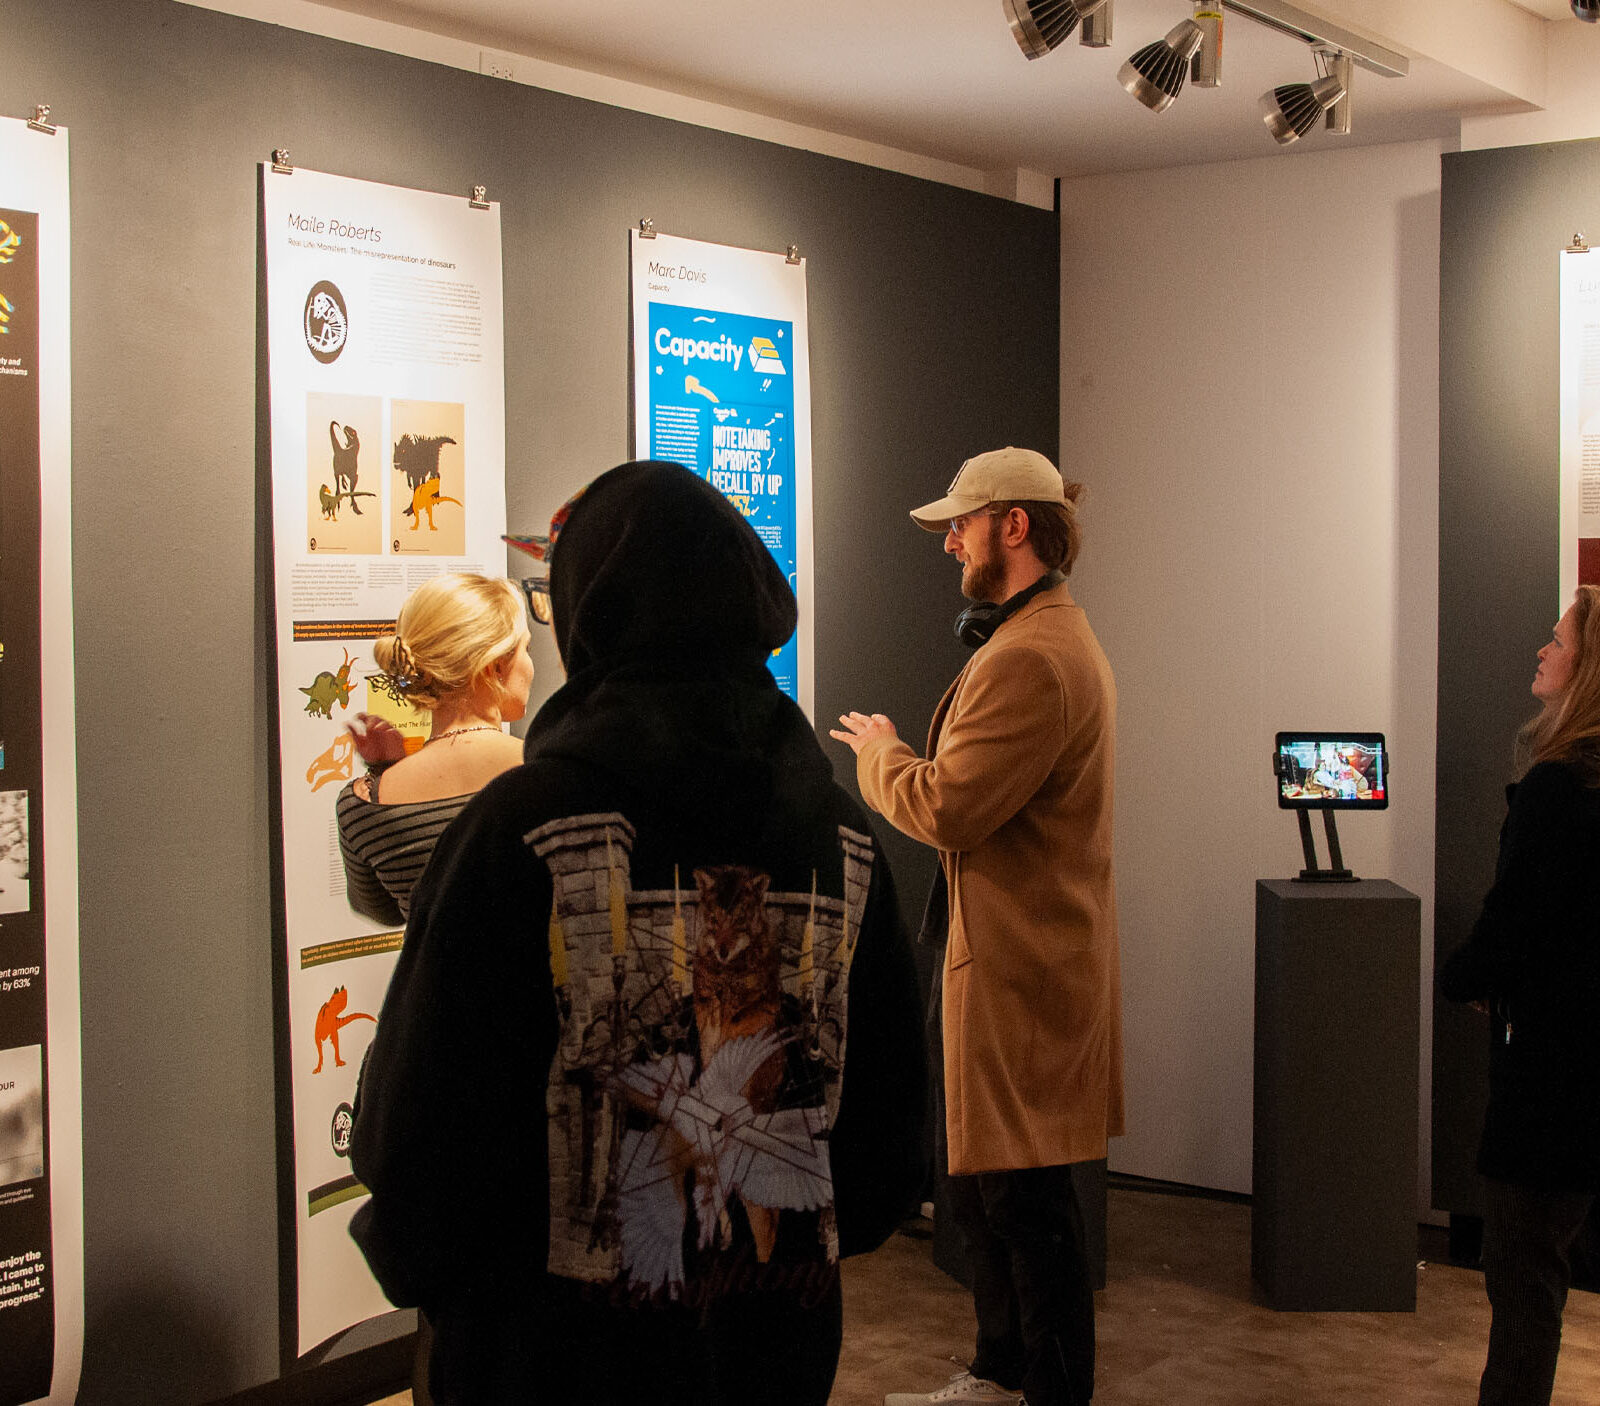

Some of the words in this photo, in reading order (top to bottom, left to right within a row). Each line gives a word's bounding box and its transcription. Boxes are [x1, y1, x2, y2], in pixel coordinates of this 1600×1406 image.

[288, 212, 325, 233] Maile
[328, 219, 382, 243] Roberts
[288, 237, 301, 247] Real
[303, 239, 315, 249] Life
[350, 246, 362, 255] The
[363, 249, 418, 264] misrepresentation
[419, 257, 427, 265] of
[427, 258, 457, 270] dinosaurs
[648, 261, 676, 279] Marc
[678, 266, 707, 283] Davis
[648, 282, 671, 292] Capacity
[655, 327, 743, 371] Capacity
[713, 425, 771, 451] NOTETAKING
[713, 448, 761, 472] IMPROVES
[712, 470, 750, 494] RECALL
[751, 473, 765, 495] BY
[767, 474, 782, 496] UP
[11, 966, 40, 977] among
[2, 980, 12, 992] by
[13, 977, 31, 989] 63%
[0, 1255, 25, 1269] enjoy
[25, 1250, 41, 1262] the
[8, 1266, 34, 1279] came
[34, 1263, 45, 1272] to
[24, 1276, 40, 1288] but
